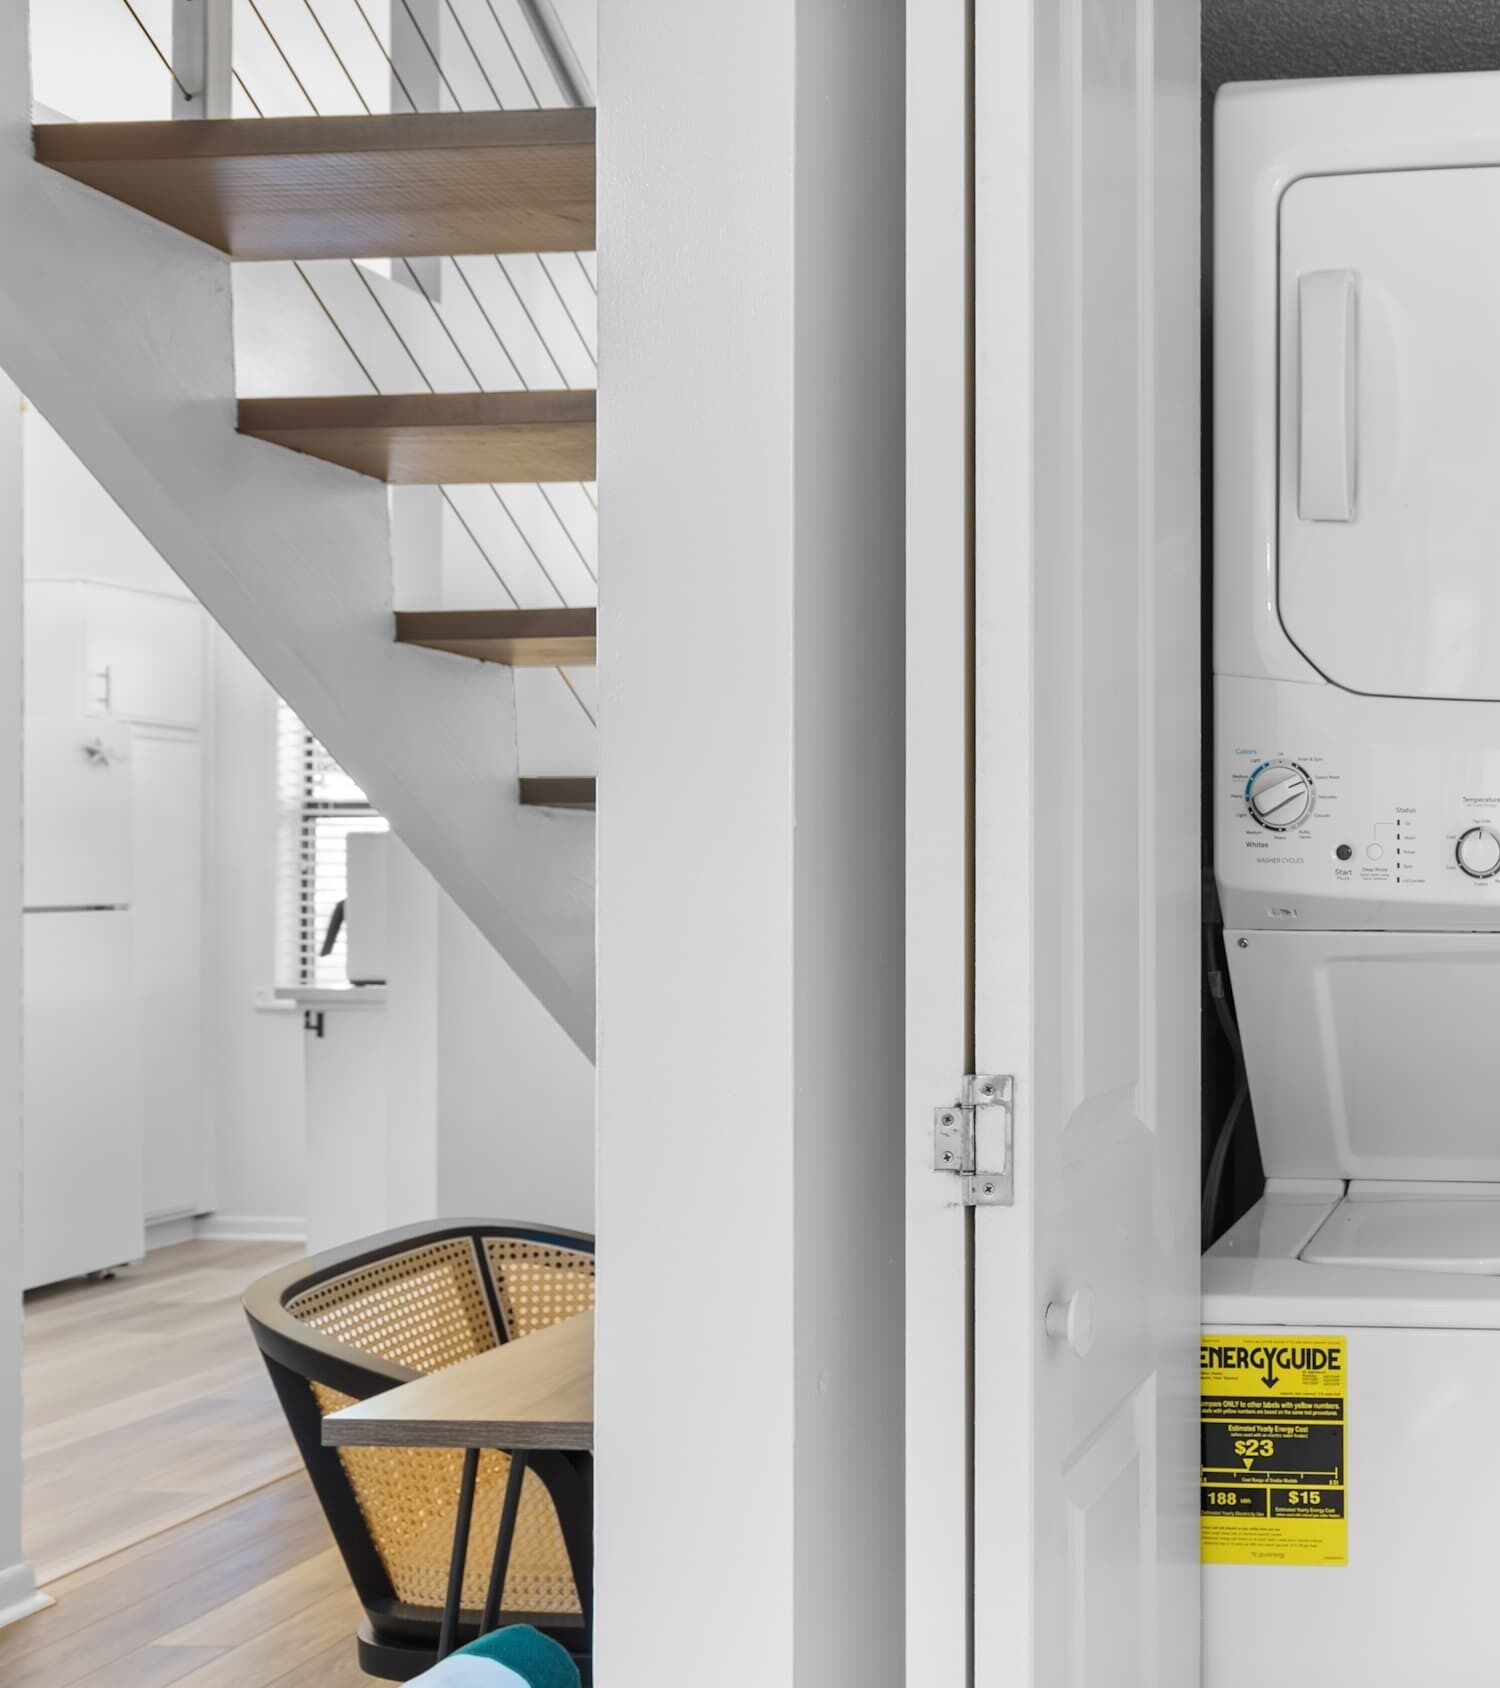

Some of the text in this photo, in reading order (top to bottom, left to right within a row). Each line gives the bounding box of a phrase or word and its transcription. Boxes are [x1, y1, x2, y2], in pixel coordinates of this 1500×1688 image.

[1462, 796, 1500, 804] Temperature
[1335, 868, 1352, 876] Start
[1201, 1346, 1341, 1370] ENERGYGUIDE
[1294, 1402, 1313, 1410] yellow
[1257, 1425, 1274, 1433] Yearly
[1274, 1426, 1294, 1434] Energy
[1234, 1440, 1274, 1457] $23
[1208, 1492, 1237, 1505] 188
[1288, 1491, 1320, 1504] $15
